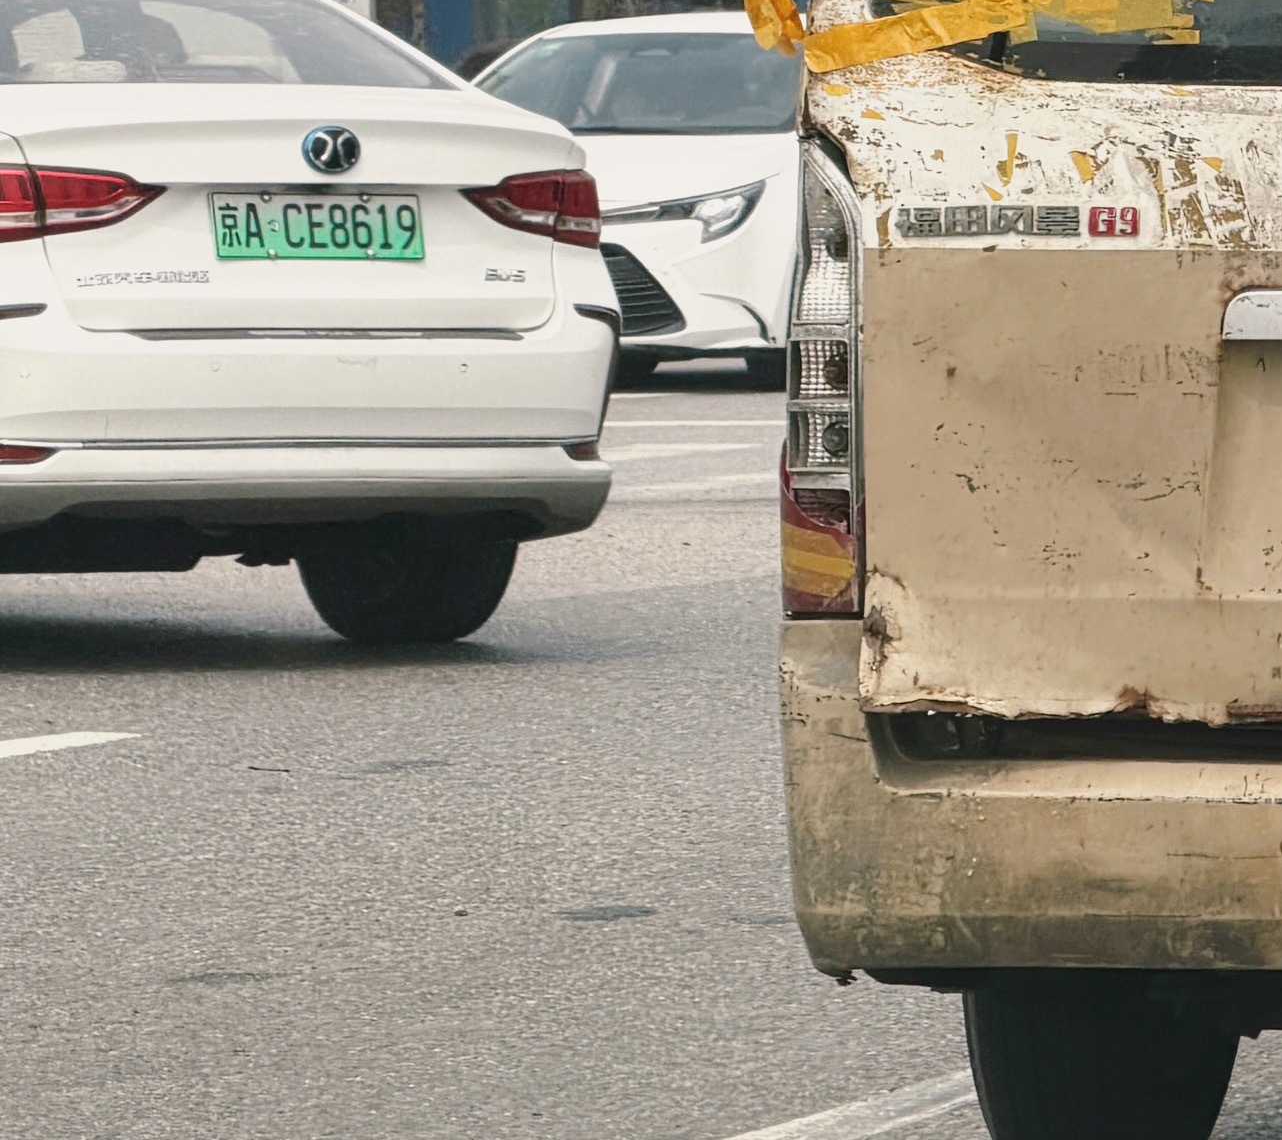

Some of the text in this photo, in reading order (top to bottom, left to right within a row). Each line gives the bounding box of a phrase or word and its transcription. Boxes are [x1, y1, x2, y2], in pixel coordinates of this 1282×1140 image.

[894, 205, 1140, 237] 福田风景 G9
